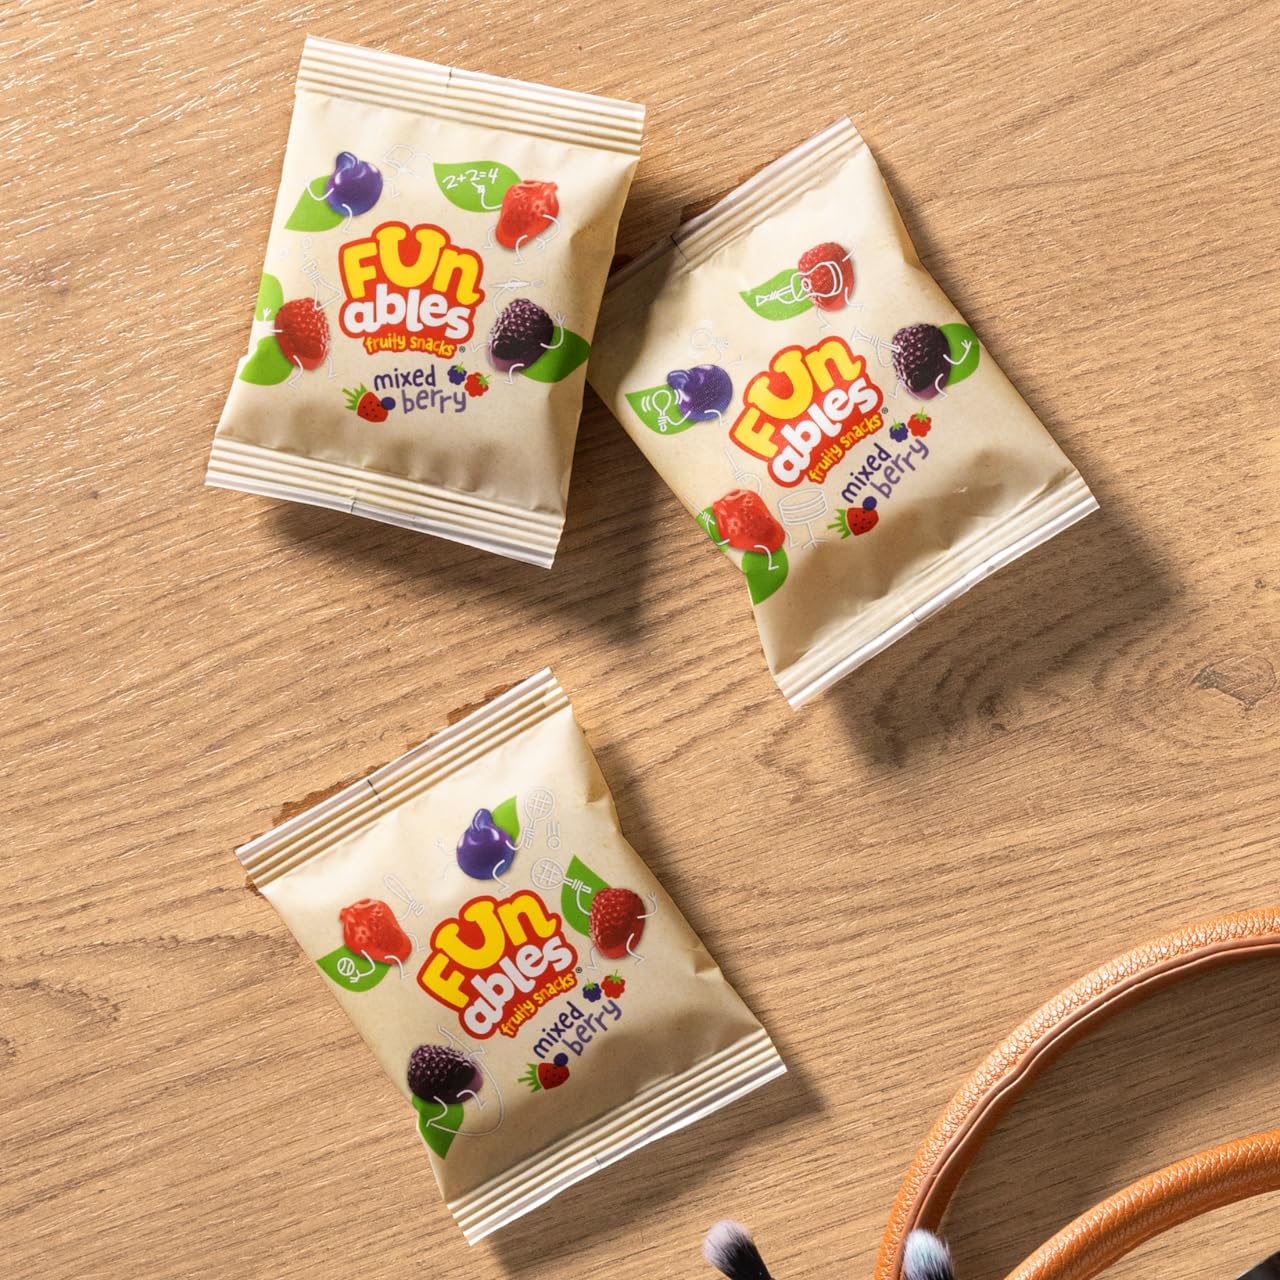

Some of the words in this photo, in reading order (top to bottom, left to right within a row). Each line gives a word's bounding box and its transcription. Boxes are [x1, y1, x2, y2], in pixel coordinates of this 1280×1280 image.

[442, 168, 499, 190] 2+2=4
[344, 284, 471, 339] ables
[365, 333, 406, 352] fruity
[409, 336, 455, 356] snacks
[374, 364, 436, 391] mixed
[402, 390, 467, 414] berry
[772, 378, 878, 483] ables
[809, 444, 843, 482] fruity
[840, 414, 882, 447] snacks
[841, 442, 892, 504] mixed
[870, 438, 930, 499] berry
[464, 936, 572, 1035] ables
[501, 1000, 536, 1036] fruity
[533, 974, 576, 1005] snacks
[532, 1001, 585, 1059] mixed
[562, 1000, 623, 1056] berry
